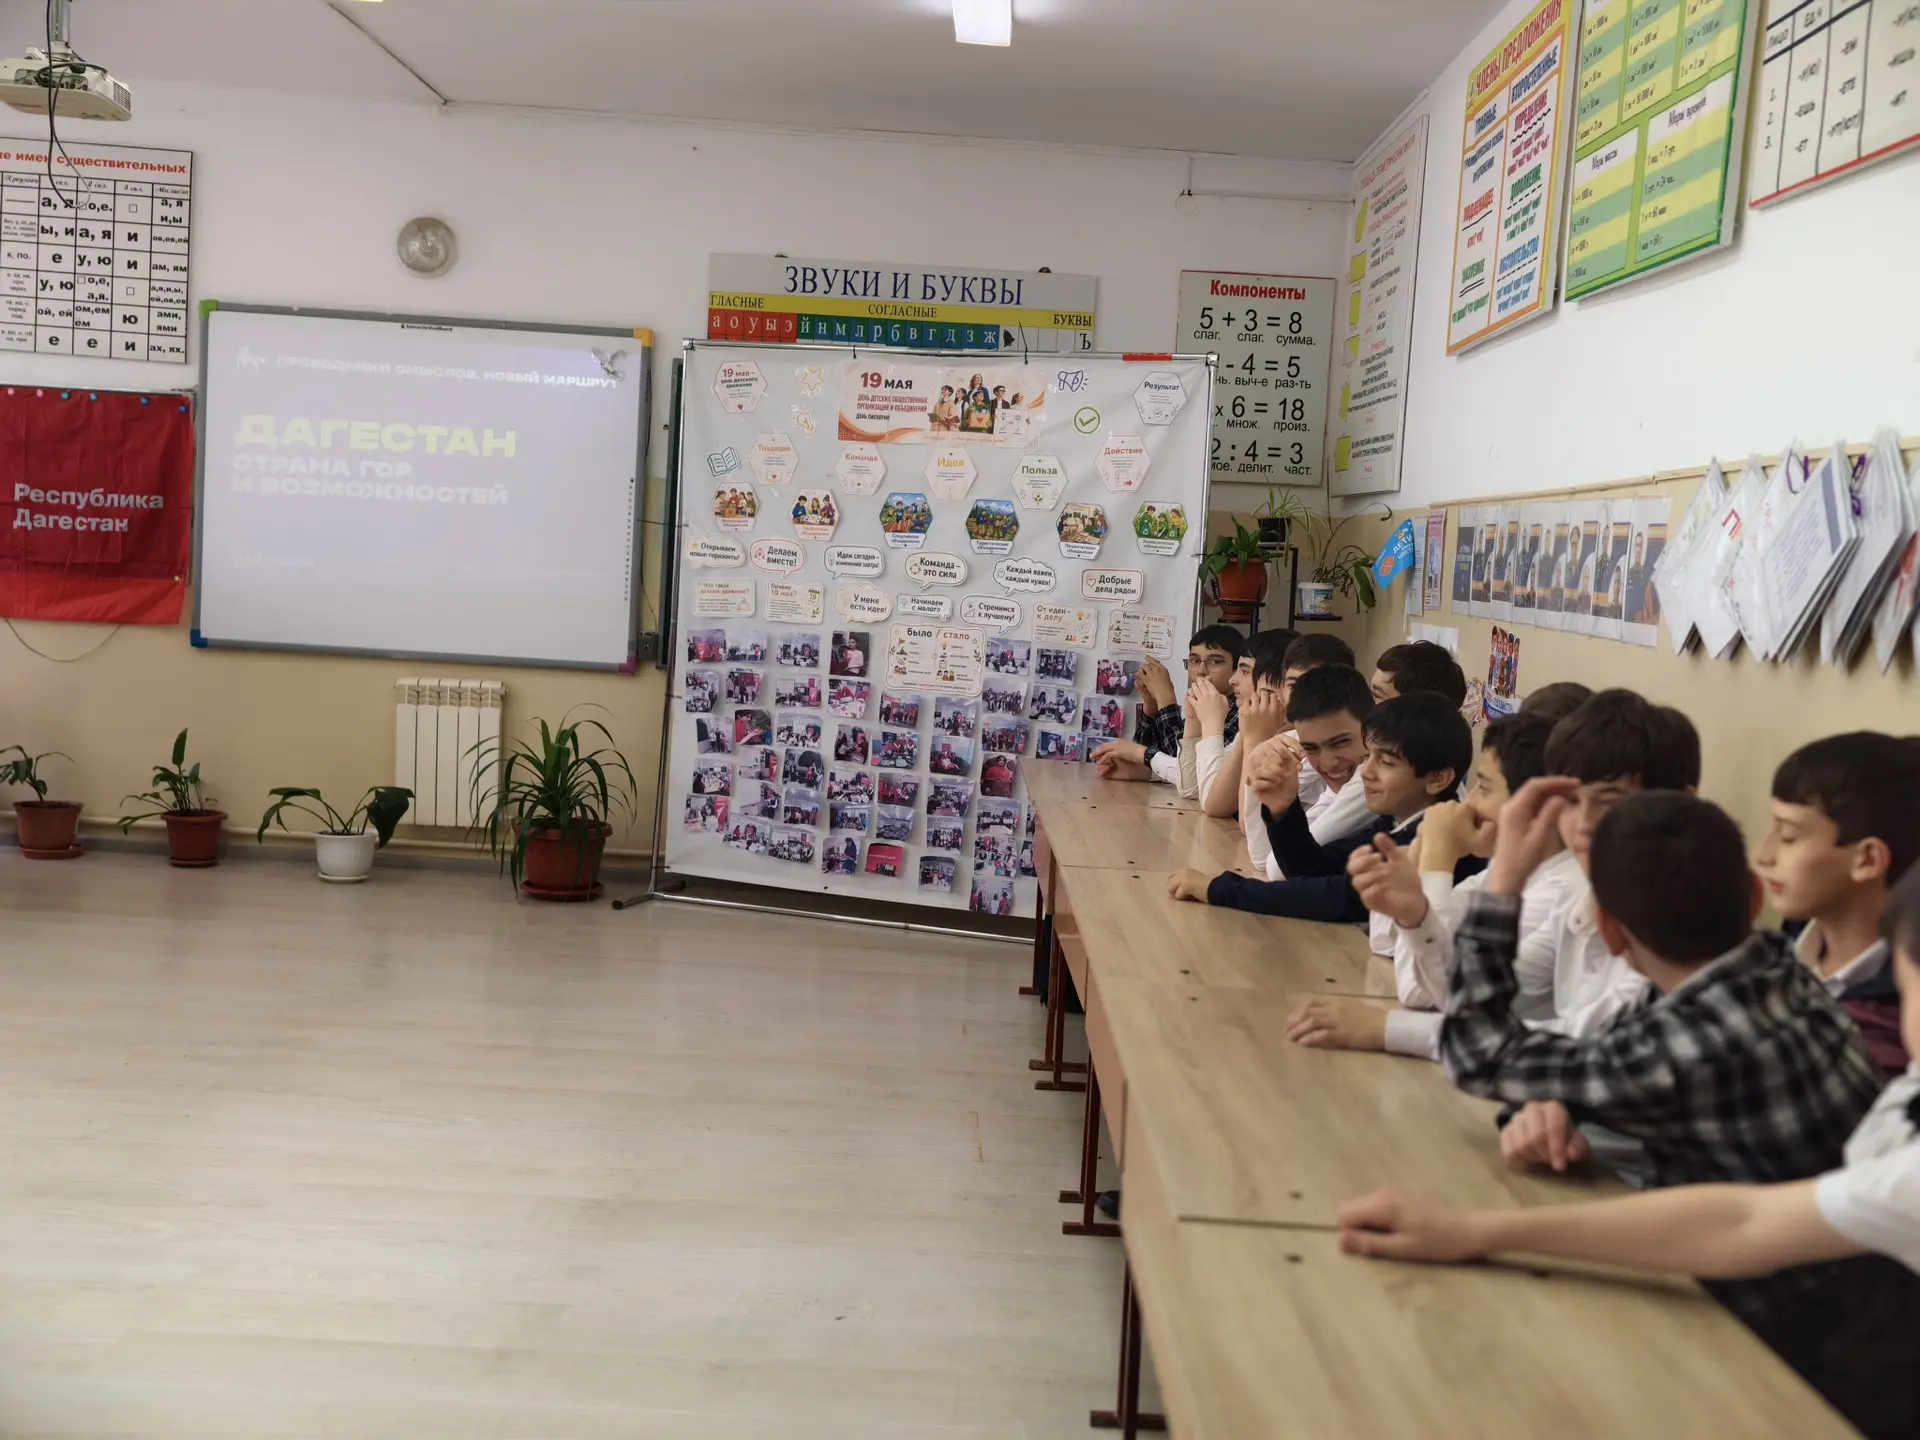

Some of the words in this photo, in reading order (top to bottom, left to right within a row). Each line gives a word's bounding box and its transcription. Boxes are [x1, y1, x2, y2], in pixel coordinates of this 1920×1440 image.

[1476, 53, 1502, 97] ЧЛЕНЫ
[56, 154, 186, 174] существительных
[64, 226, 75, 237] и
[101, 229, 112, 240] я
[127, 232, 138, 242] и
[51, 252, 63, 264] е
[97, 256, 112, 266] ю
[127, 259, 138, 270] и
[60, 280, 74, 291] ю
[784, 265, 882, 297] ЗВУКИ
[891, 271, 912, 299] И
[920, 273, 1025, 305] БУКВЫ
[1209, 279, 1306, 301] Компоненты
[710, 294, 765, 309] ГЛАСНЫЕ
[867, 303, 938, 319] СОГЛАСНЫЕ
[122, 313, 138, 325] ю
[1053, 313, 1092, 327] БУКВЫ
[1199, 306, 1213, 330] 5
[1244, 308, 1258, 332] 3
[1288, 311, 1303, 335] 8
[48, 335, 60, 346] е
[87, 338, 98, 349] е
[1193, 329, 1221, 341] слаг.
[1236, 331, 1265, 344] слаг.
[1275, 334, 1316, 346] сумма.
[125, 340, 136, 352] и
[1241, 353, 1256, 376] 4
[1286, 355, 1301, 378] 5
[483, 370, 540, 385] НОВЫЙ
[722, 368, 734, 378] 19
[860, 371, 882, 388] 19
[884, 379, 913, 390] МАЯ
[1143, 381, 1180, 391] Результат
[1234, 376, 1269, 387] выч-е
[1274, 379, 1312, 390] раз-ть
[857, 393, 870, 402] ДЕНЬ
[1231, 395, 1246, 418] 6
[1278, 397, 1305, 421] 18
[1226, 418, 1260, 430] множ.
[1273, 421, 1311, 433] произ.
[233, 412, 519, 459] ДАГЕСТАН
[1104, 447, 1143, 455] Действие
[1244, 439, 1259, 462] 4
[1289, 442, 1304, 465] 3
[845, 453, 878, 462] Команда
[937, 457, 965, 468] Идея
[232, 453, 351, 477] СТРАНА
[359, 459, 414, 479] ГОР
[1021, 465, 1058, 475] Польза
[1237, 462, 1275, 474] делит.
[1284, 465, 1313, 476] част.
[13, 482, 164, 510] Республика
[231, 475, 253, 493] И
[260, 477, 509, 506] ВОЗМОЖНОСТЕЙ
[12, 508, 129, 532] Дагестан
[700, 542, 736, 552] Открываем
[767, 545, 798, 557] Делаем
[766, 557, 797, 567] вместе!
[836, 551, 853, 560] Идеи
[853, 553, 875, 561] сегодня
[919, 557, 955, 569] Команда
[923, 568, 939, 578] это
[939, 569, 958, 579] сила
[1005, 564, 1032, 575] Каждый
[1005, 575, 1030, 584] каждый
[1030, 579, 1052, 587] нужен!
[1098, 574, 1132, 586] Добрые
[1094, 586, 1113, 594] дела
[1114, 587, 1137, 595] рядом
[853, 594, 860, 602] У
[860, 597, 880, 605] меня
[910, 597, 944, 606] Начинаем
[849, 603, 866, 611] есть
[867, 605, 888, 614] идея!
[916, 605, 941, 613] малого
[1037, 604, 1047, 612] От
[983, 612, 1015, 623] лучшему!
[1043, 614, 1063, 623] делу
[1122, 612, 1140, 620] было
[1146, 615, 1166, 623] стало
[907, 627, 933, 637] было
[943, 631, 970, 640] стало
